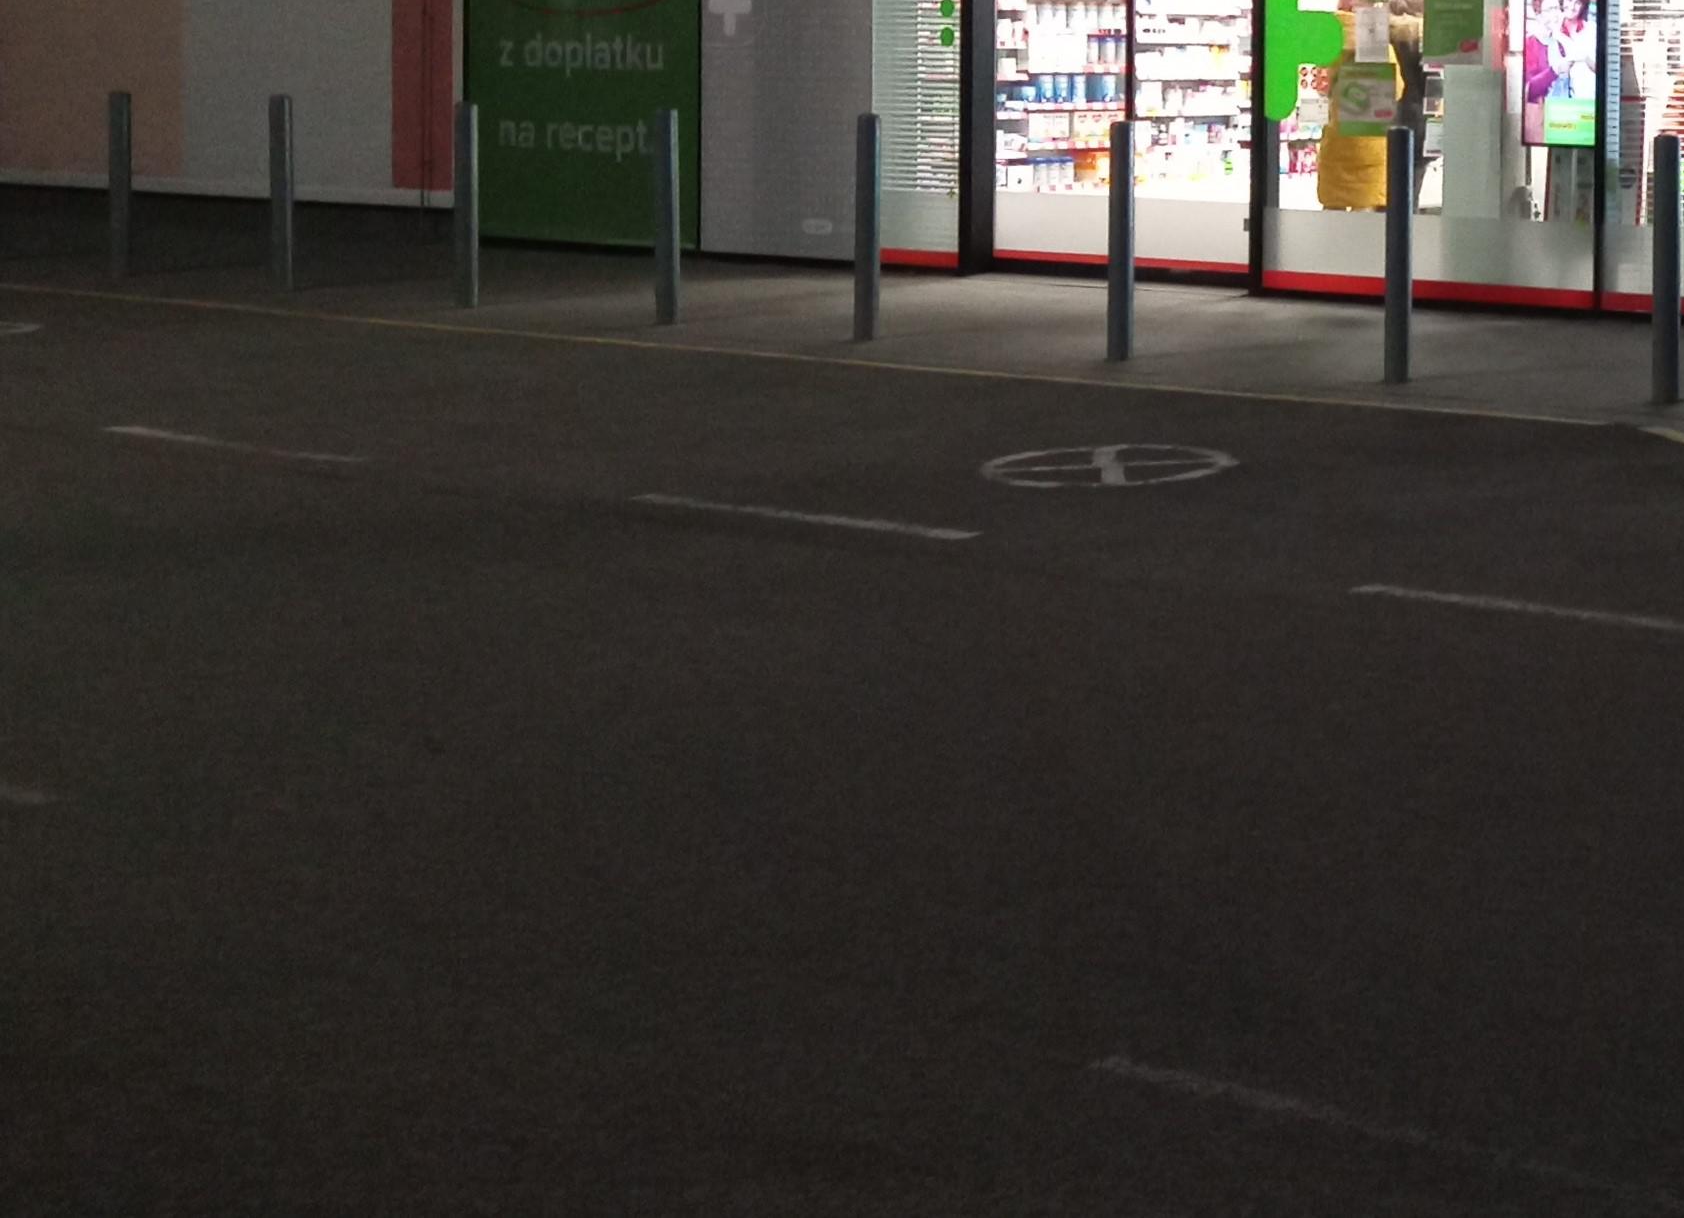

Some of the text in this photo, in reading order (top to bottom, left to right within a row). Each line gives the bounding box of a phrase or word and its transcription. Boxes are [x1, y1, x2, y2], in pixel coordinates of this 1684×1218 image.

[498, 32, 665, 78] z doplatku
[498, 118, 535, 148] na
